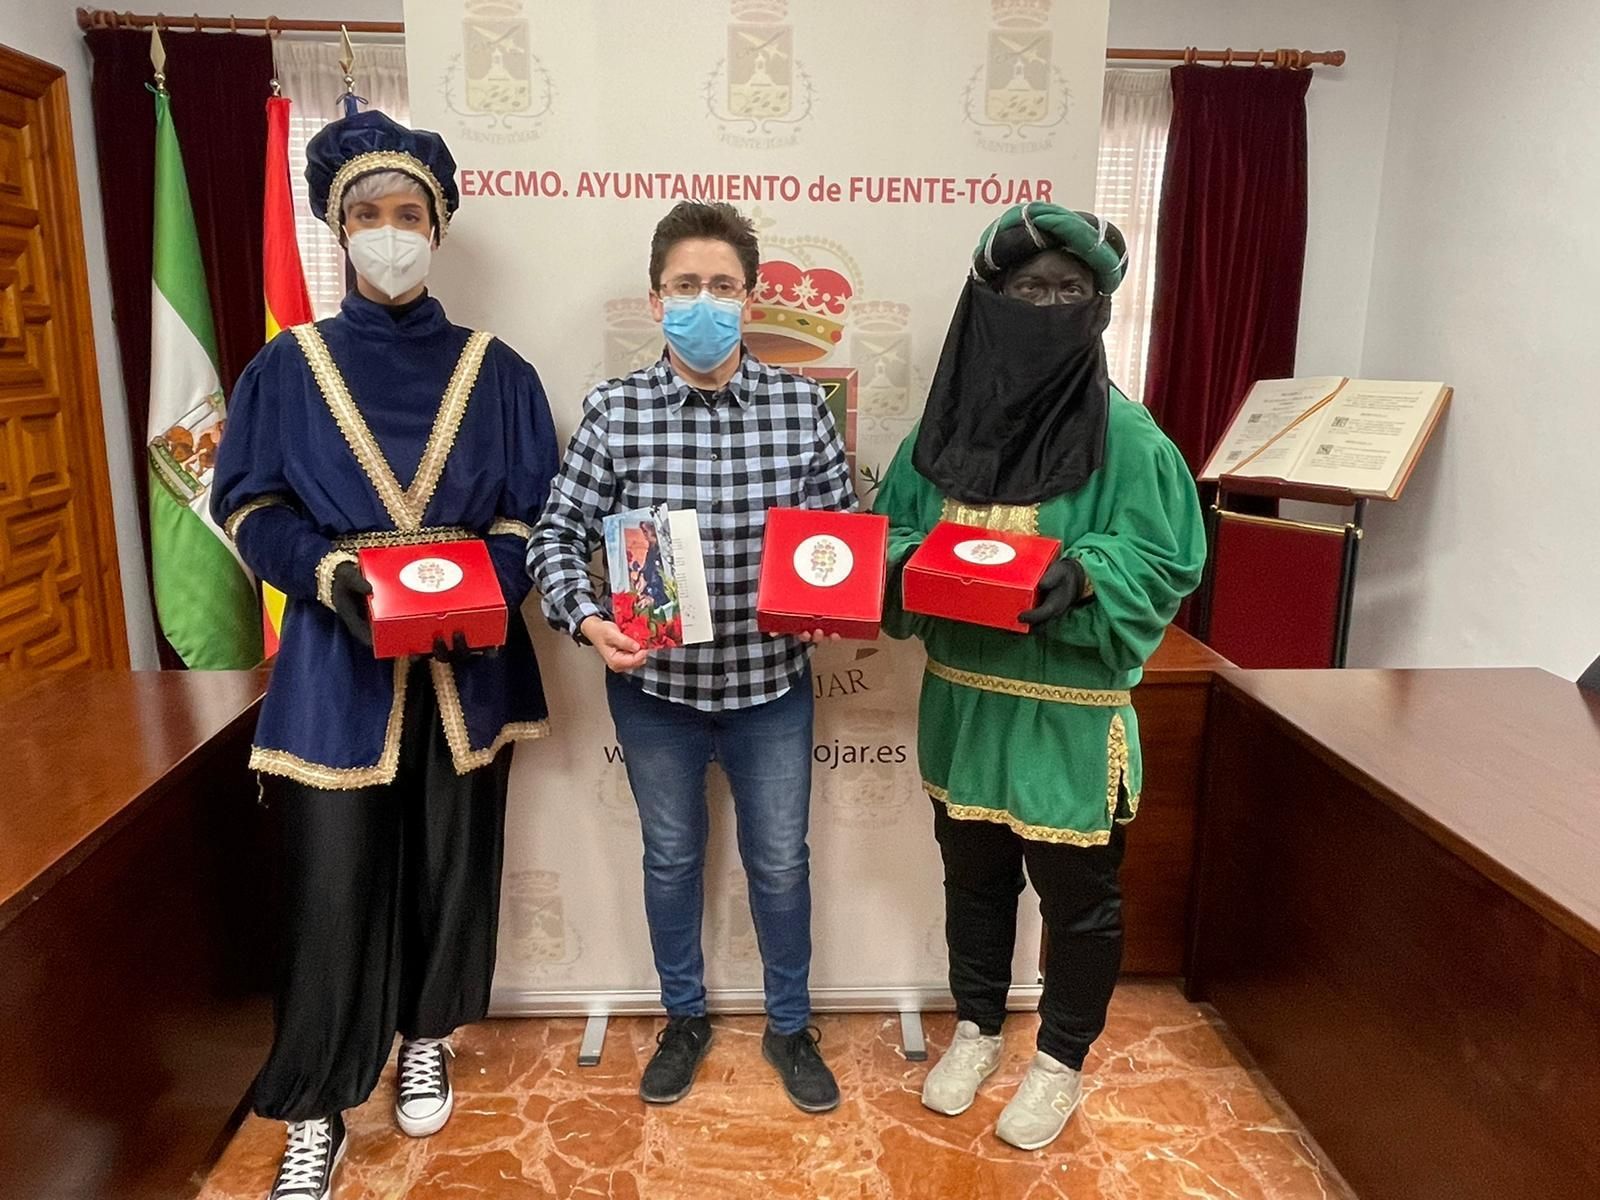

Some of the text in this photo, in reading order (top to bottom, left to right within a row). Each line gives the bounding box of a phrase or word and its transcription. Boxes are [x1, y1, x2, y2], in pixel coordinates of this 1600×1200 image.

[460, 170, 1054, 205] EXCMO. AYUNTAMIENTO de FUENTE-TÓJAR
[814, 668, 870, 699] JAR
[603, 739, 907, 770] w ojar.es
